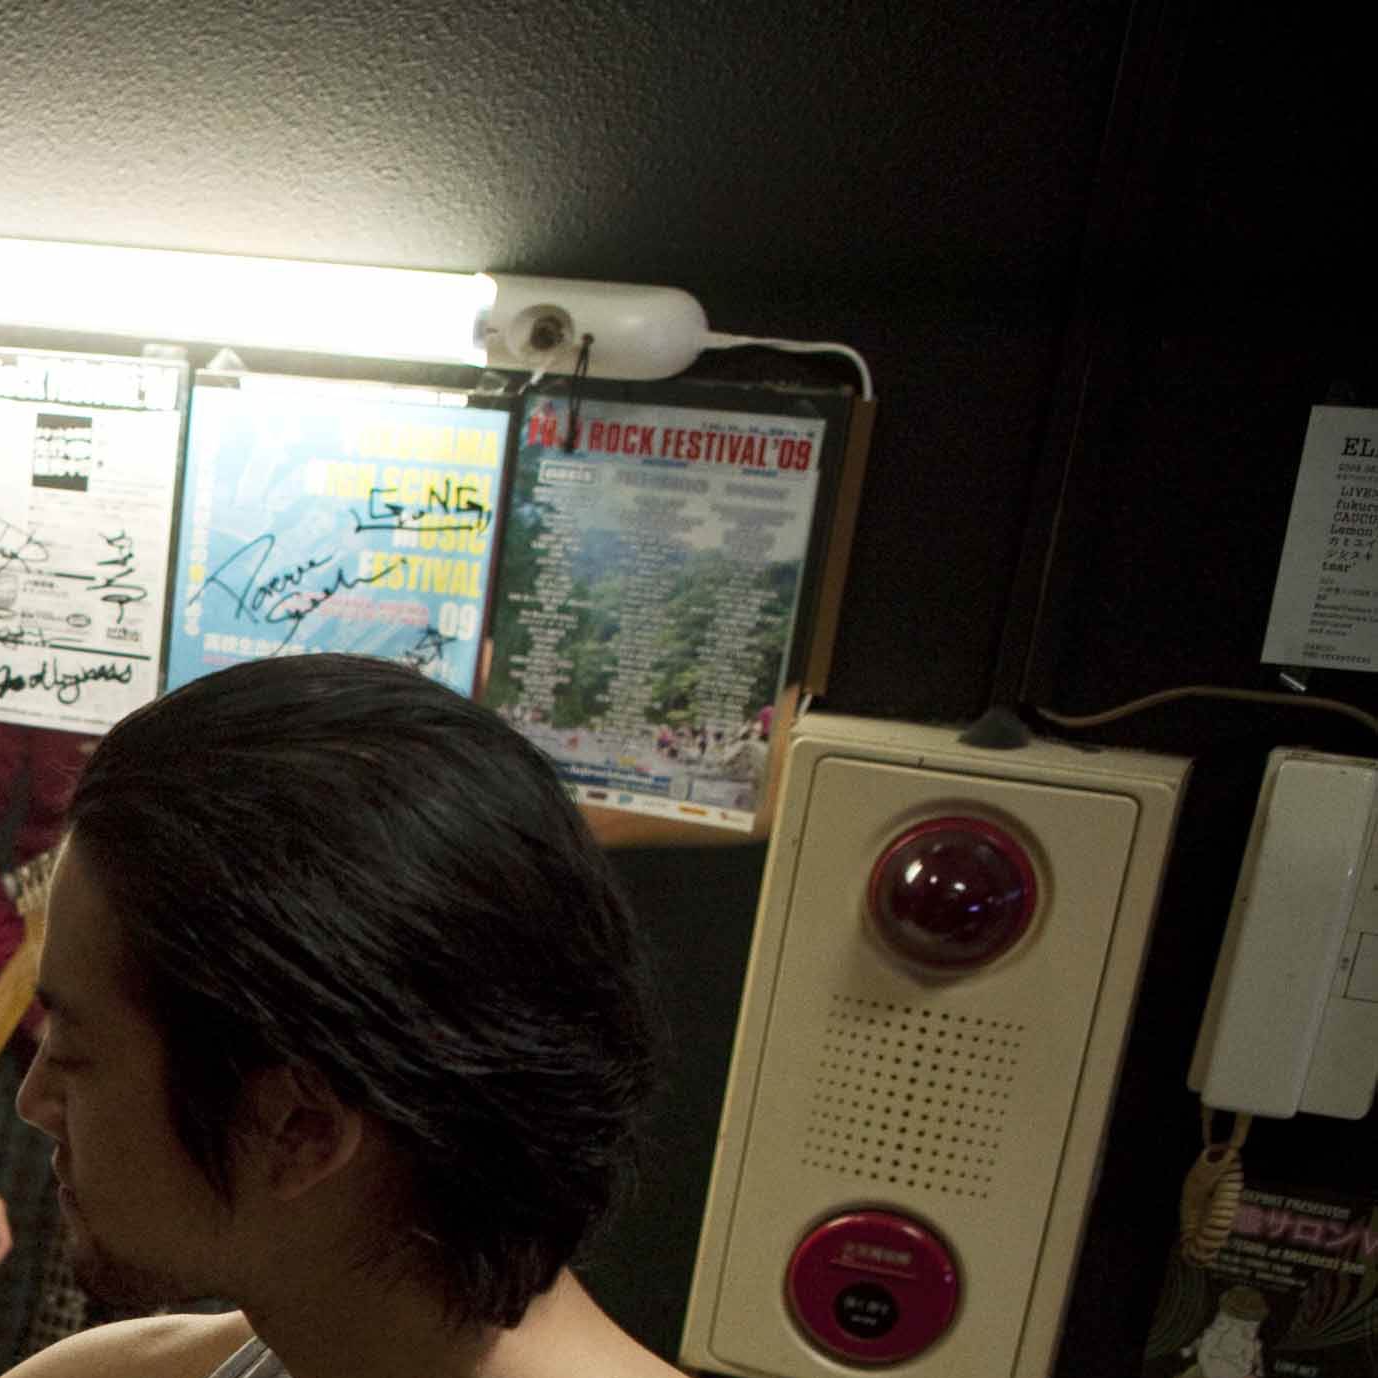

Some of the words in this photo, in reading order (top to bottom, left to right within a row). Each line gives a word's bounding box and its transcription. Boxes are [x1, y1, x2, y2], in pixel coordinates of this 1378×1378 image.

[527, 415, 583, 450] FUI
[587, 418, 655, 457] ROCK
[660, 426, 769, 467] FESTIVAL
[358, 550, 481, 598] FESTIVAL
